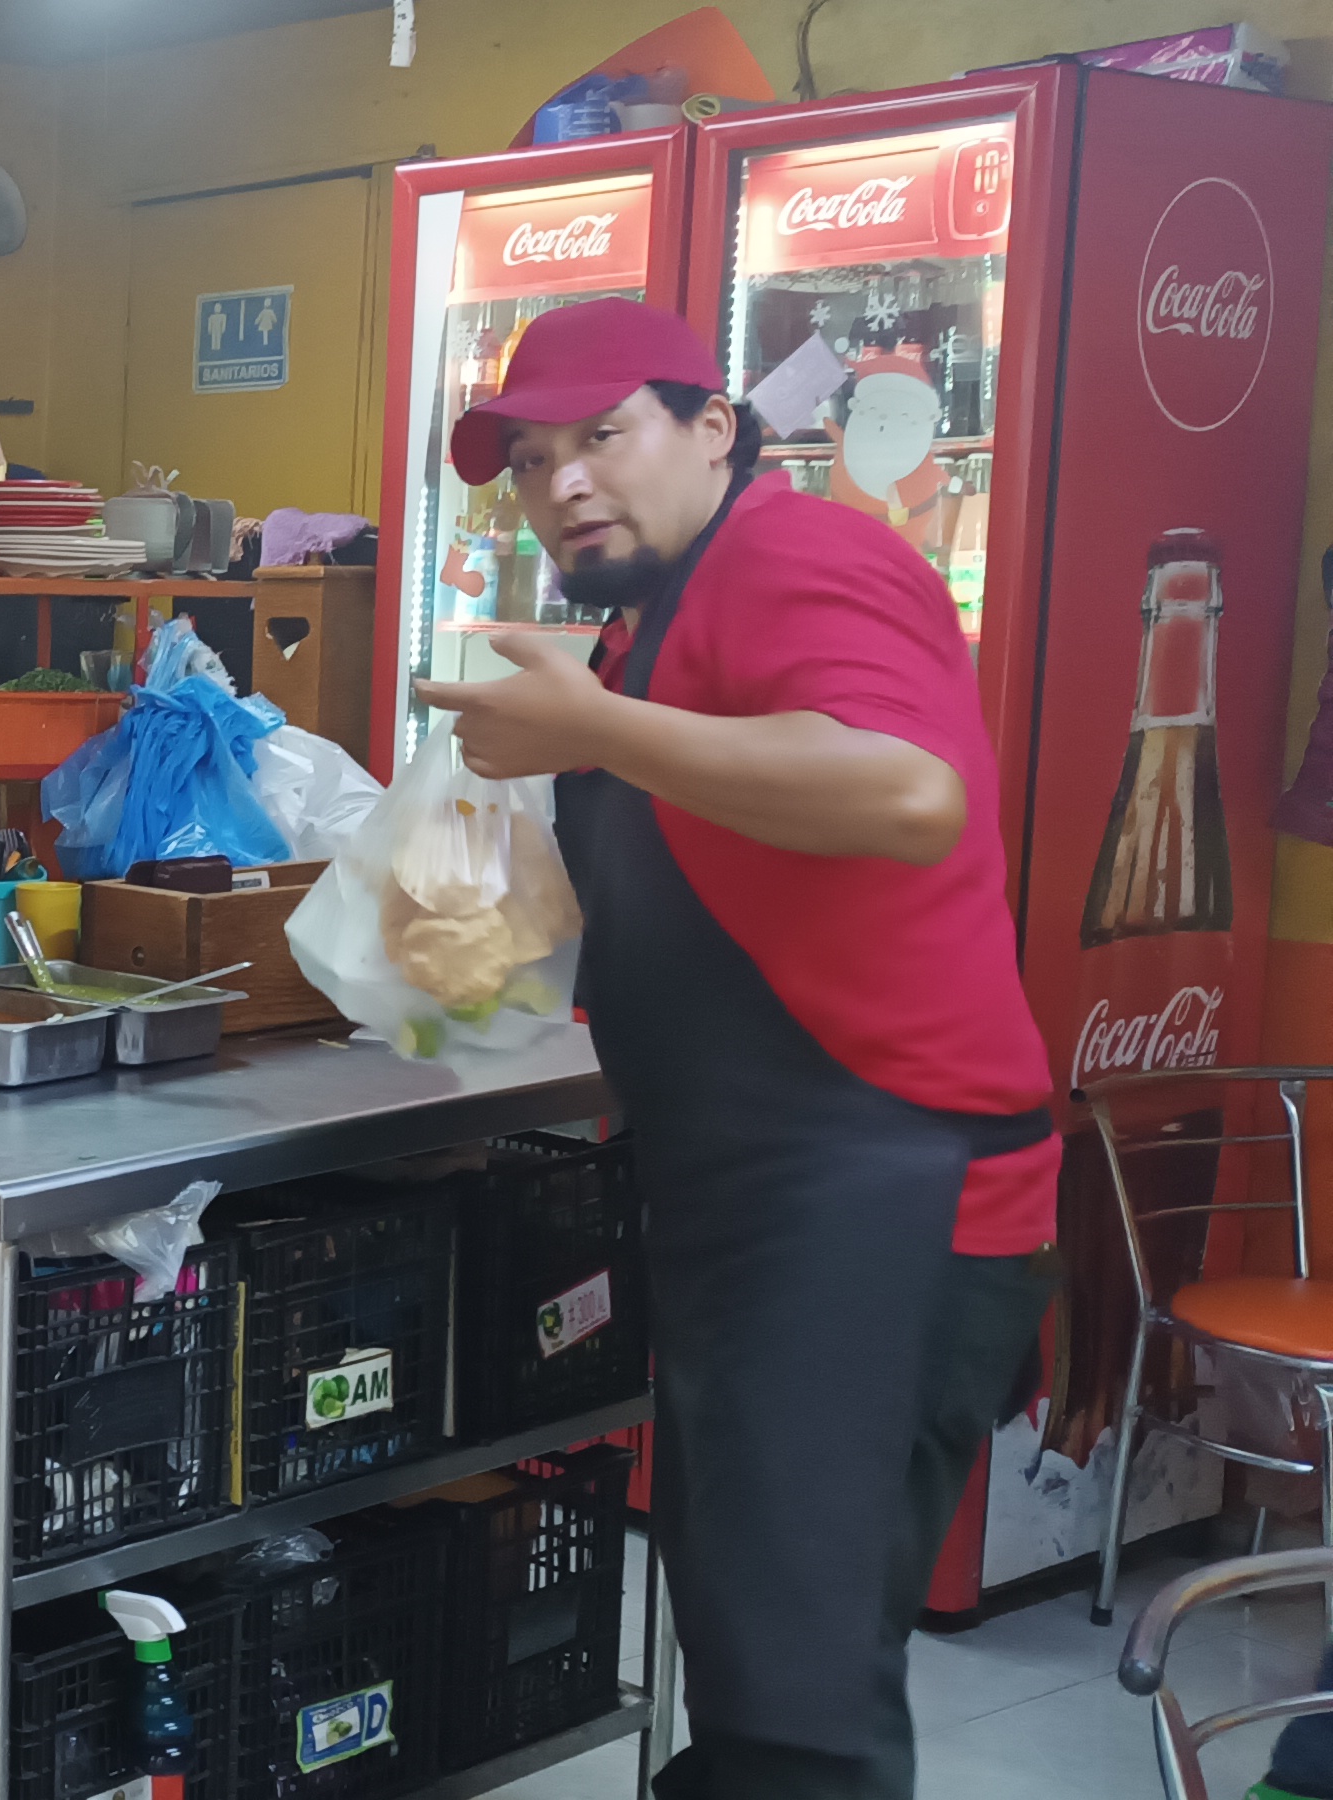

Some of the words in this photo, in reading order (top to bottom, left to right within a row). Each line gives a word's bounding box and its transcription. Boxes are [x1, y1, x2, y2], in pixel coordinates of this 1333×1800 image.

[777, 174, 917, 235] Coca-Cola
[502, 212, 620, 267] Coca-Cola
[1145, 264, 1267, 341] Coca-Cola
[202, 362, 280, 382] SANITARIOS
[1071, 986, 1223, 1088] Coca-Cola
[350, 1367, 389, 1407] AM
[365, 1692, 388, 1741] D
